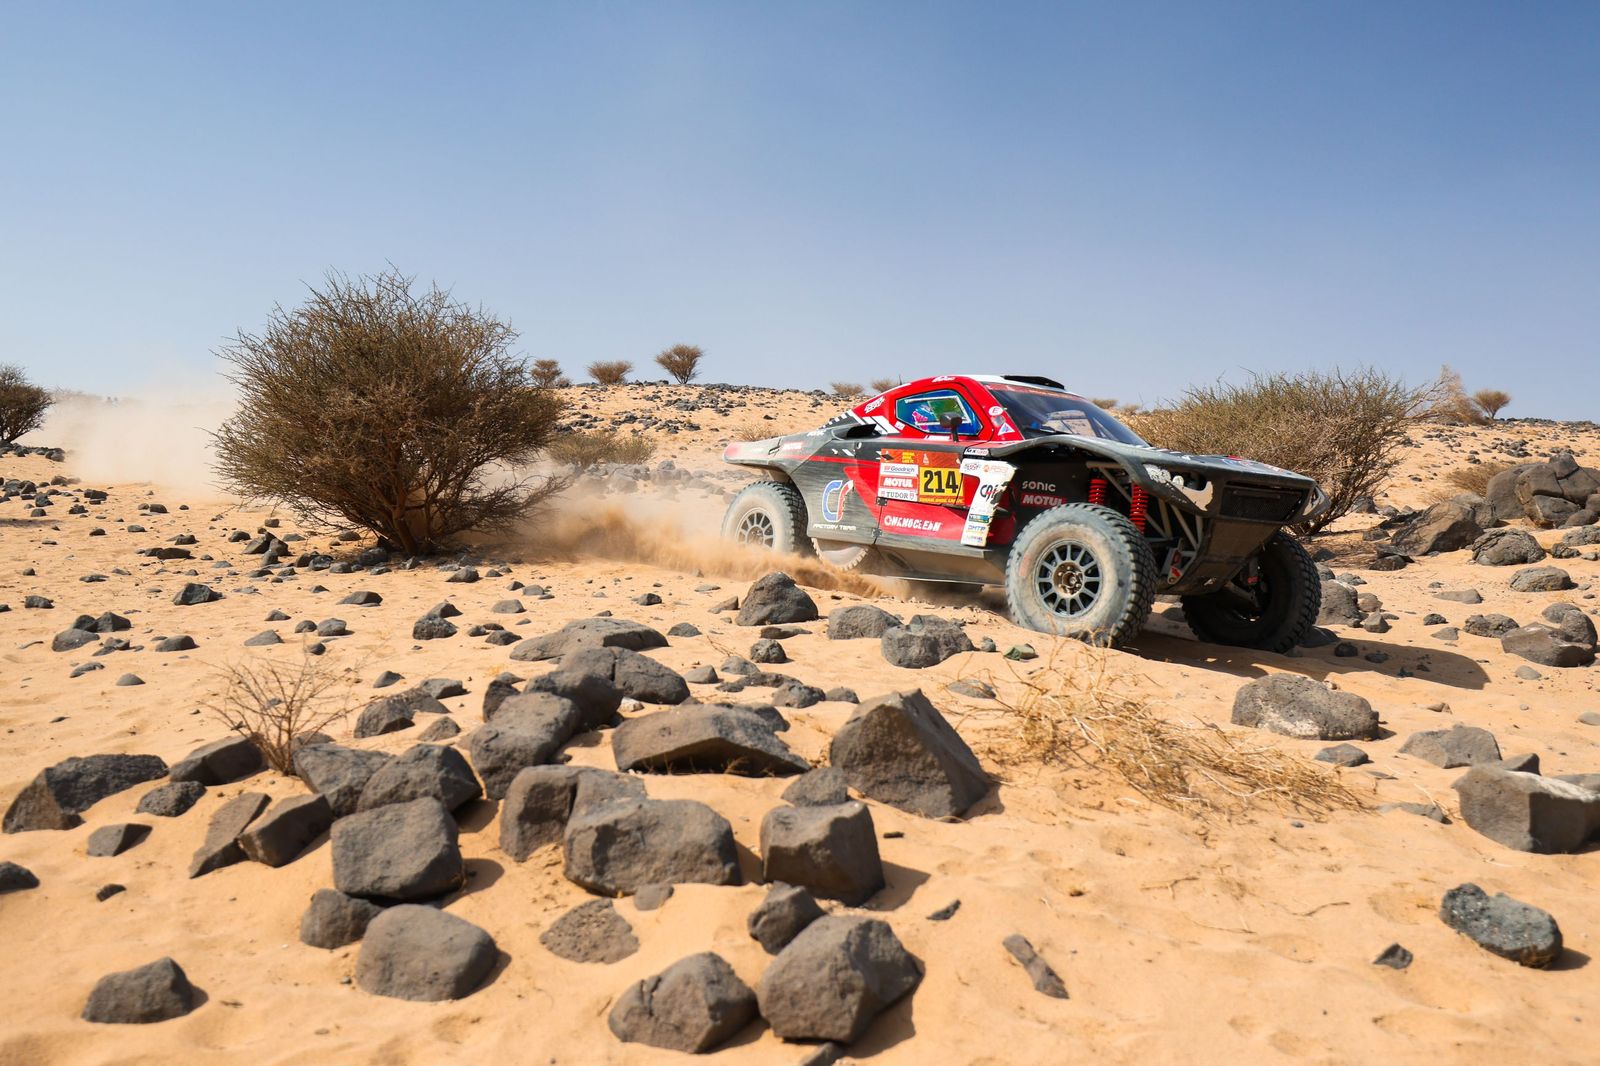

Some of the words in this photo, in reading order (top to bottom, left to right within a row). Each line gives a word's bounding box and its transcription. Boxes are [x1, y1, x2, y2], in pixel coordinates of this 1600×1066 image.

[883, 477, 913, 488] MOTUL
[923, 469, 959, 493] 214
[886, 491, 908, 499] TUDOR
